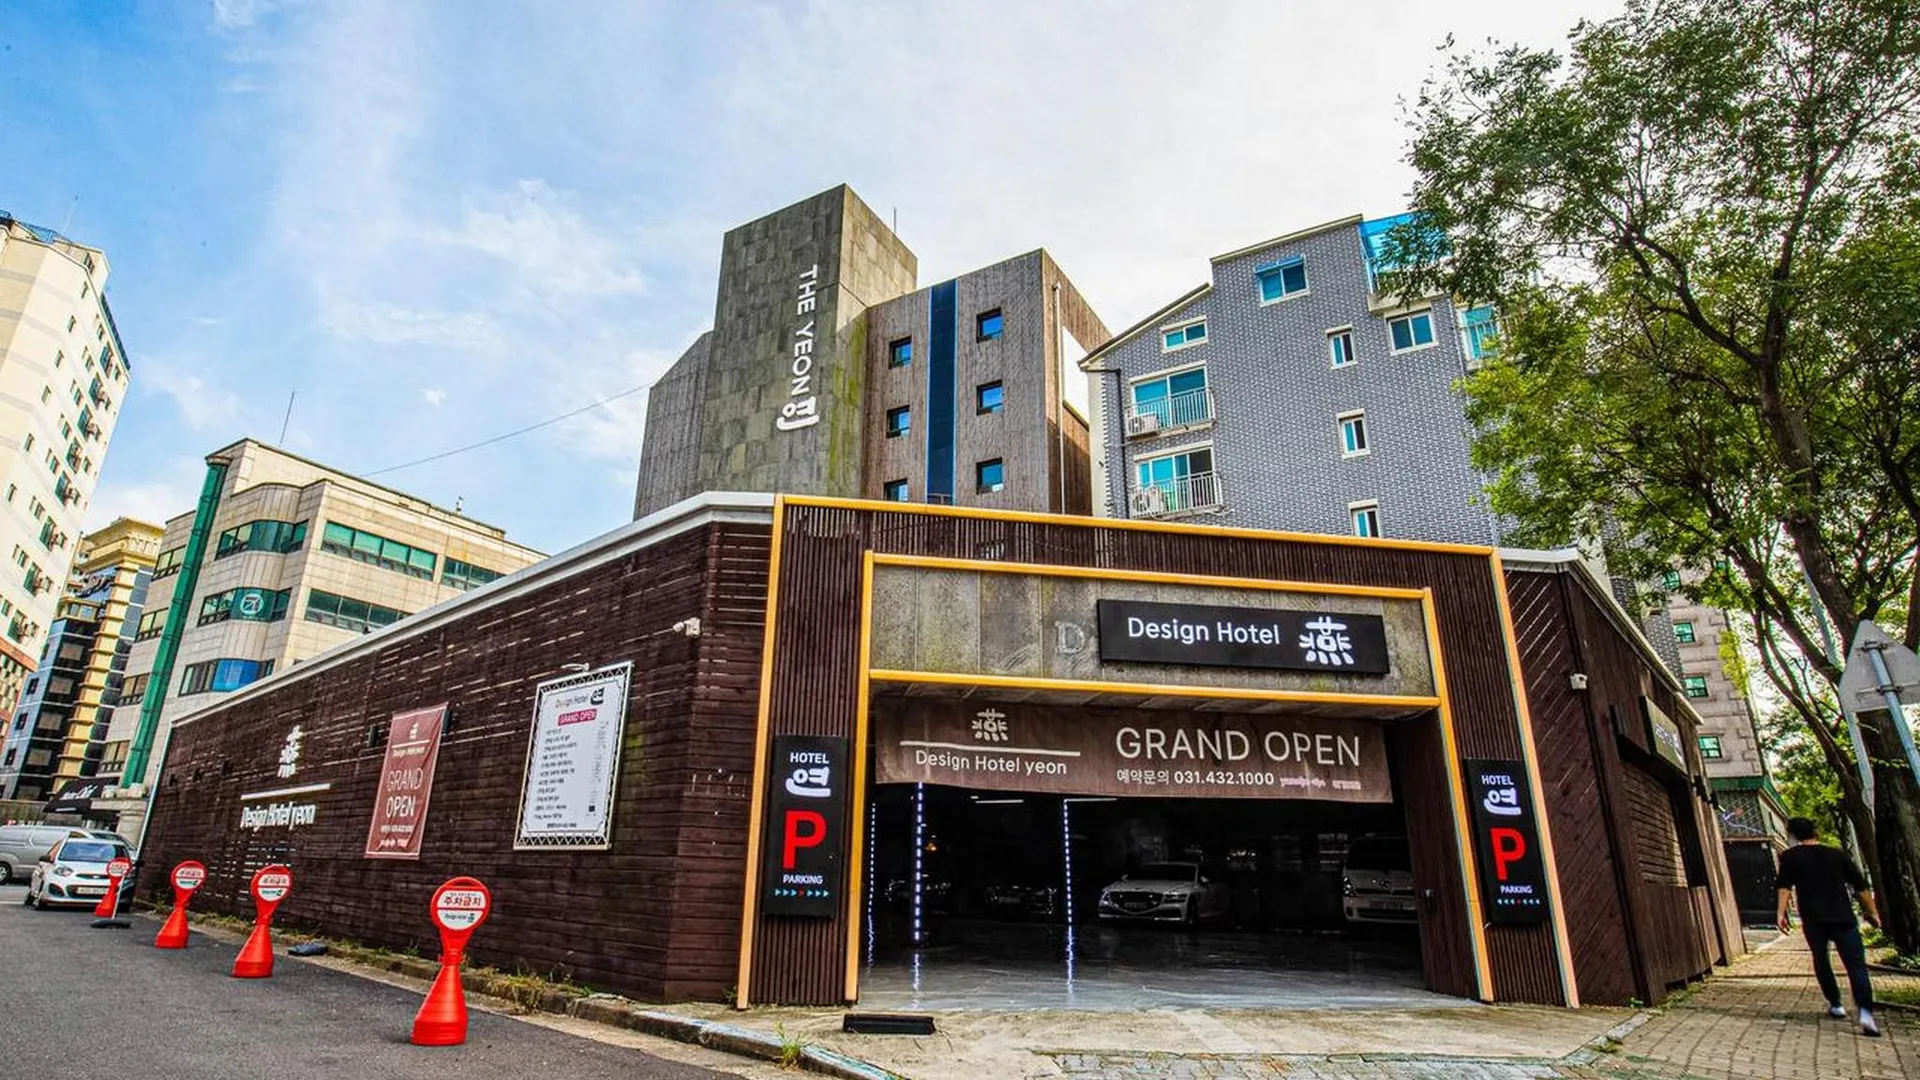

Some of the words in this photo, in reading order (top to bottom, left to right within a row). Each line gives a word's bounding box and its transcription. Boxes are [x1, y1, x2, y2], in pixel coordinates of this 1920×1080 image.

[797, 264, 818, 316] THE
[792, 320, 814, 396] YEON
[1127, 617, 1210, 645] Design
[1216, 621, 1281, 645] Hotel
[579, 709, 596, 721] OPEN
[789, 752, 830, 764] HOTEL
[1115, 727, 1250, 761] GRAND
[1264, 731, 1360, 767] OPEN
[915, 750, 970, 771] Design
[975, 756, 1020, 773] Hotel
[1025, 760, 1067, 776] yeon
[387, 767, 424, 792] GRAND
[1117, 769, 1170, 785] 예약문의
[1174, 770, 1275, 786] 031.432.1000
[1481, 774, 1515, 786] HOTEL
[240, 805, 268, 832] Design
[267, 801, 294, 826] Hotel
[288, 804, 316, 831] yeon
[385, 795, 416, 818] OPEN
[782, 810, 828, 870] P
[1489, 827, 1526, 880] P
[782, 874, 823, 885] PARKING
[1500, 885, 1533, 894] PARKING
[443, 896, 482, 907] 주차금지
